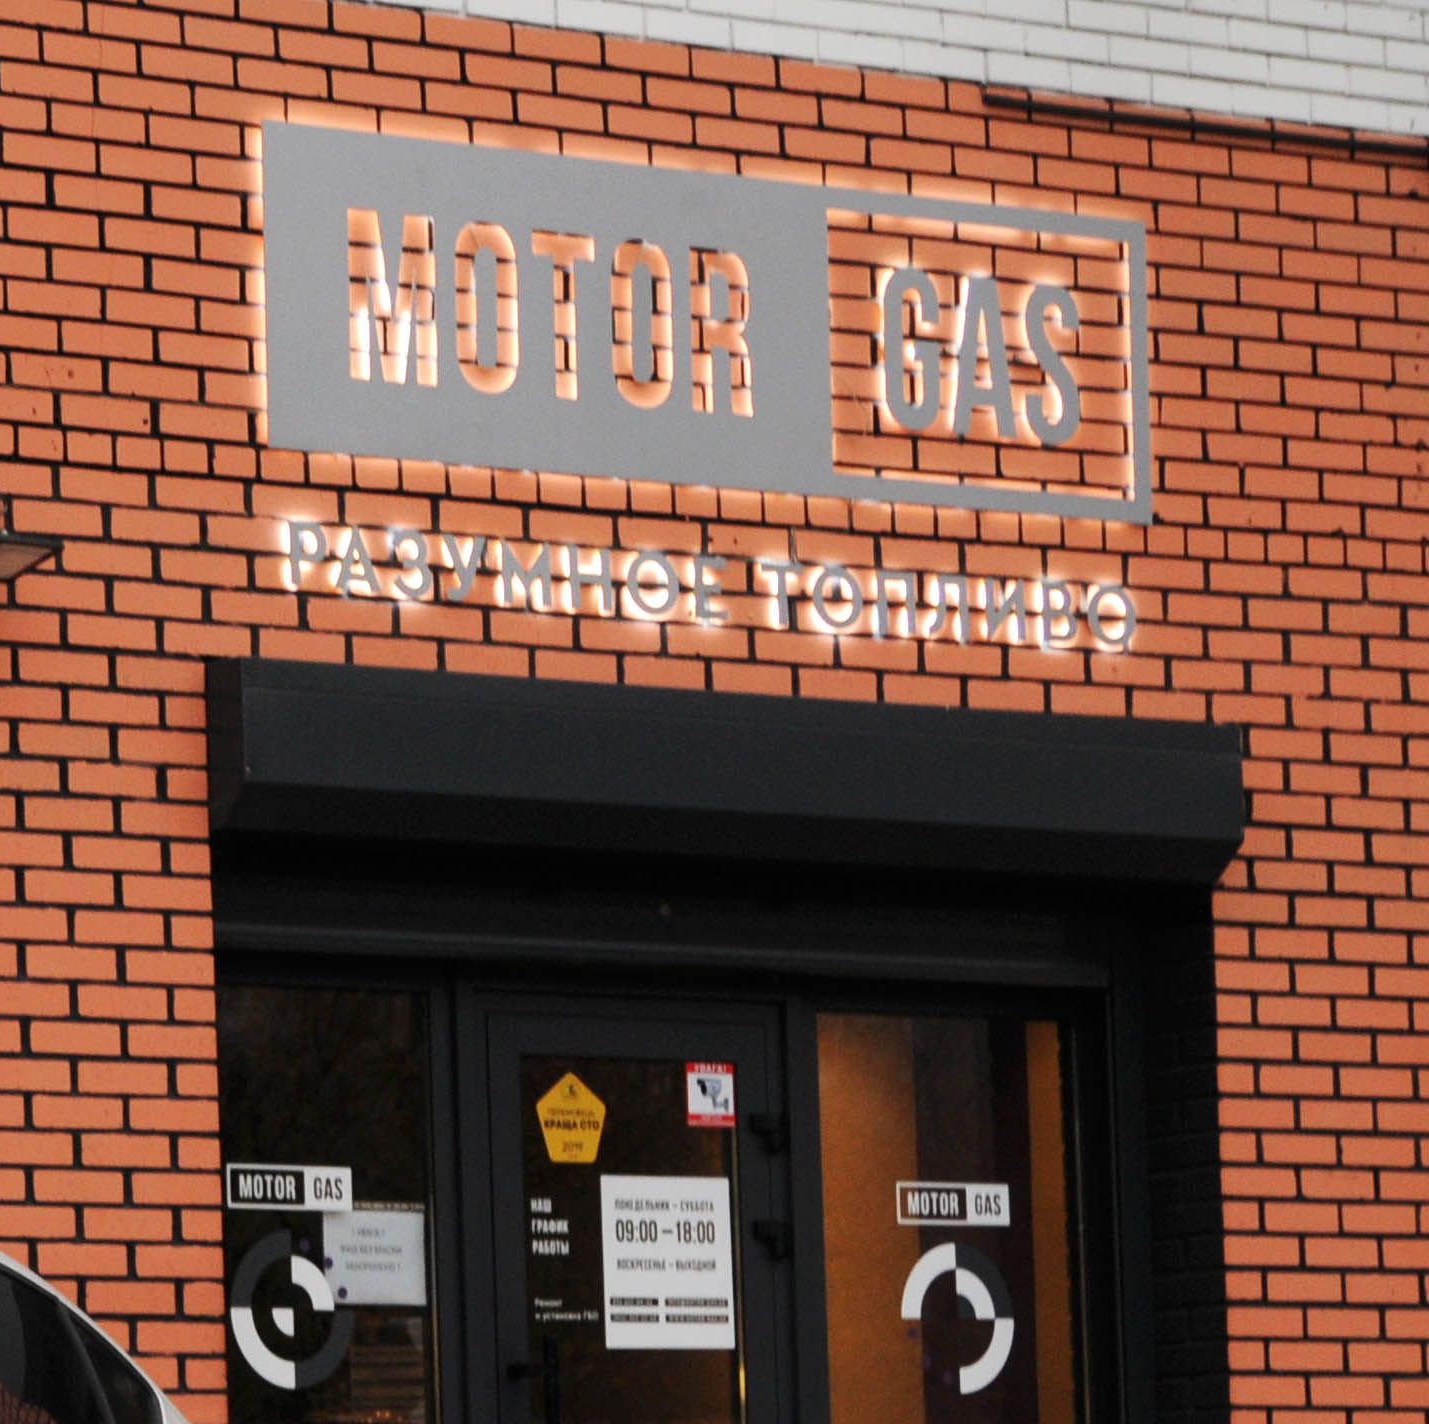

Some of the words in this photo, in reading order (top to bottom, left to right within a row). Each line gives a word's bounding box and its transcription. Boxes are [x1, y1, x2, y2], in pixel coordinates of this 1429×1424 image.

[347, 207, 755, 418] MOTOR
[880, 266, 1081, 447] GAS
[287, 519, 731, 624] РАЗУМНОЕ
[761, 558, 1137, 653] ТОПЛИВО
[239, 1173, 296, 1200] MOTOR
[313, 1177, 343, 1200] GAS
[531, 1197, 552, 1214] НАШ
[907, 1190, 959, 1217] MOTOR
[975, 1193, 1002, 1216] GAS
[531, 1218, 570, 1234] ГРАФИК
[615, 1219, 658, 1242] 09:00
[676, 1220, 715, 1244] 18:00
[532, 1238, 570, 1255] РАБОТЫ
